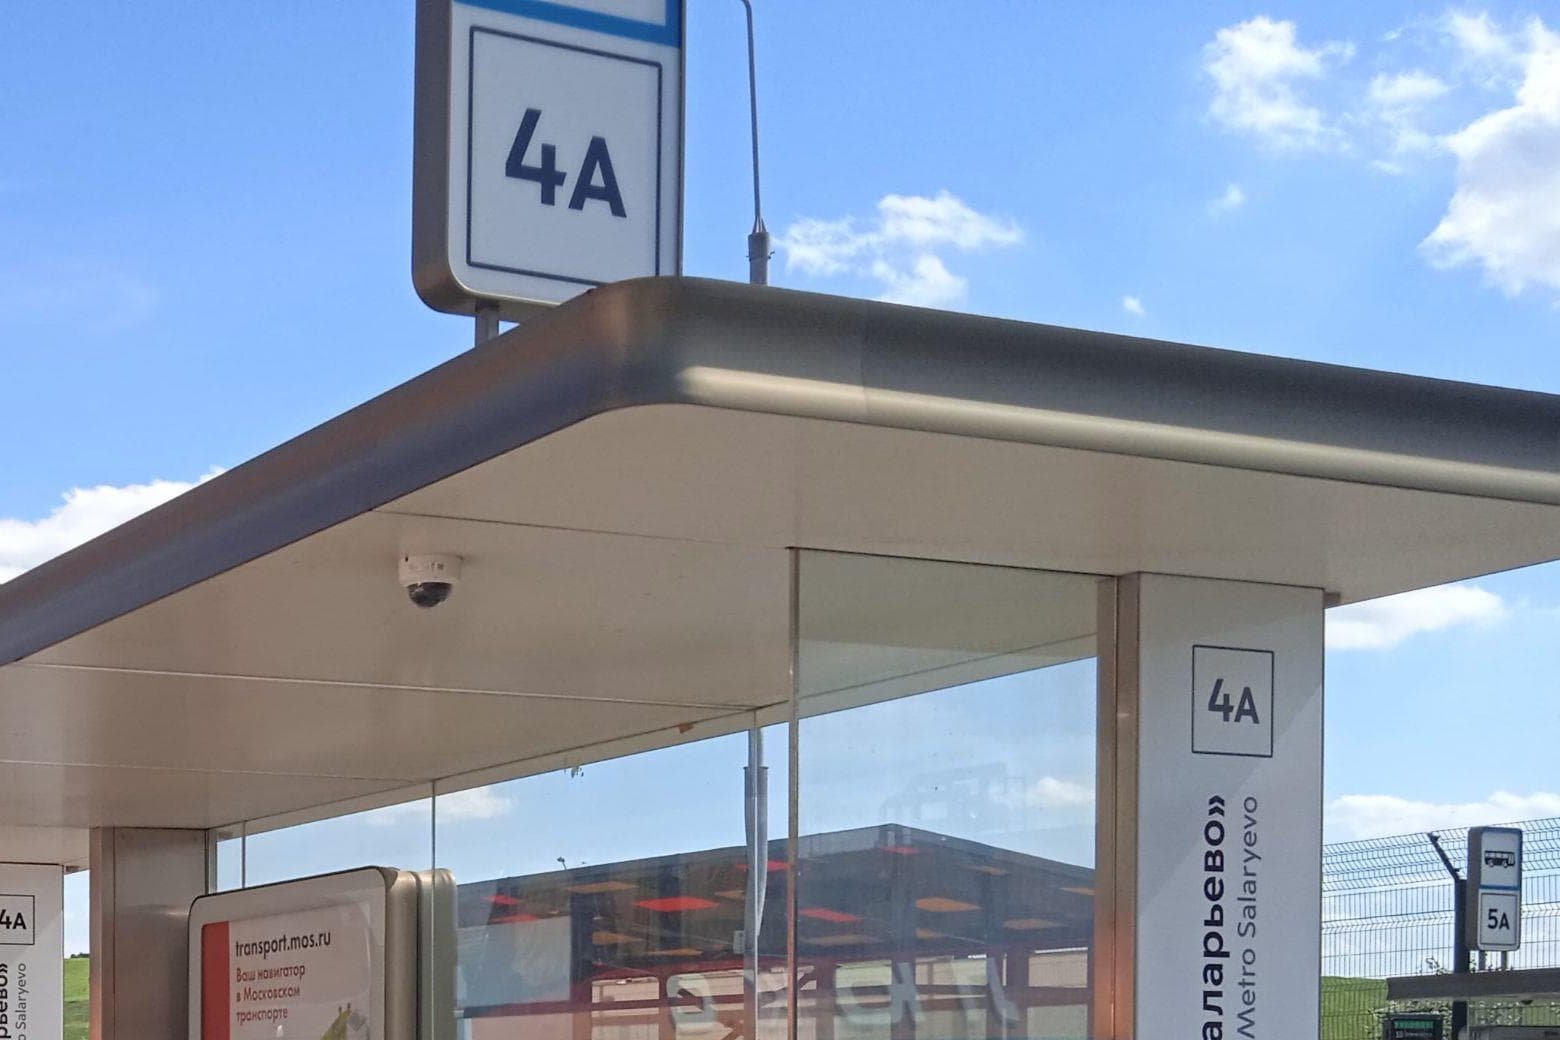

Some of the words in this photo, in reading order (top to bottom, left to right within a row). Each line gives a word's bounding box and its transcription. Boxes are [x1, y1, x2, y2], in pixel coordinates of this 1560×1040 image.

[505, 107, 627, 219] 4А
[1207, 678, 1260, 724] 4А
[1236, 796, 1262, 938] Salaryevo
[1487, 908, 1510, 930] 5А
[235, 931, 332, 960] transport.mos.ru
[236, 967, 256, 983] Ваш
[257, 965, 306, 981] навигатор
[14, 962, 30, 1030] Salaryevo
[236, 991, 242, 1002] в
[243, 986, 301, 1001] Московском
[1236, 948, 1257, 1040] Metro
[236, 1007, 289, 1026] транспорте
